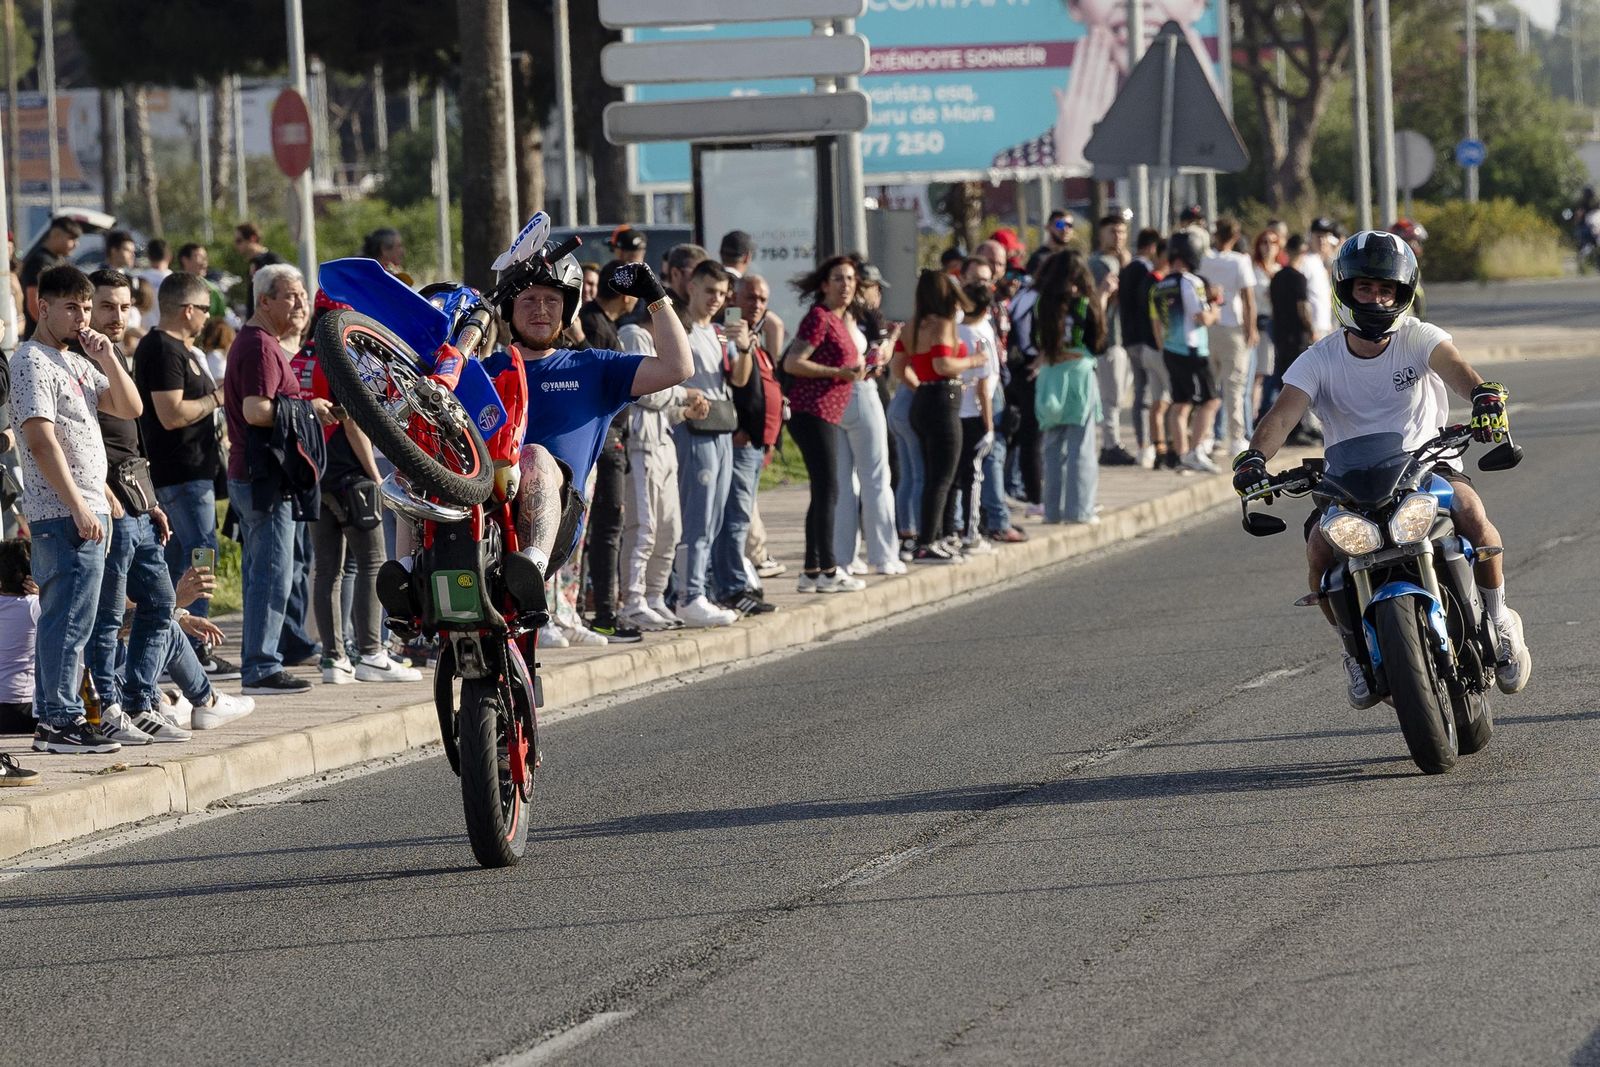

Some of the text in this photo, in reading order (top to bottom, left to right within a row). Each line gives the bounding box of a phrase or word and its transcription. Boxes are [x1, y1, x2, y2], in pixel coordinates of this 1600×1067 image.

[910, 105, 937, 124] de
[896, 130, 945, 156] 250
[549, 380, 579, 389] YAMAHA
[436, 576, 479, 618] L
